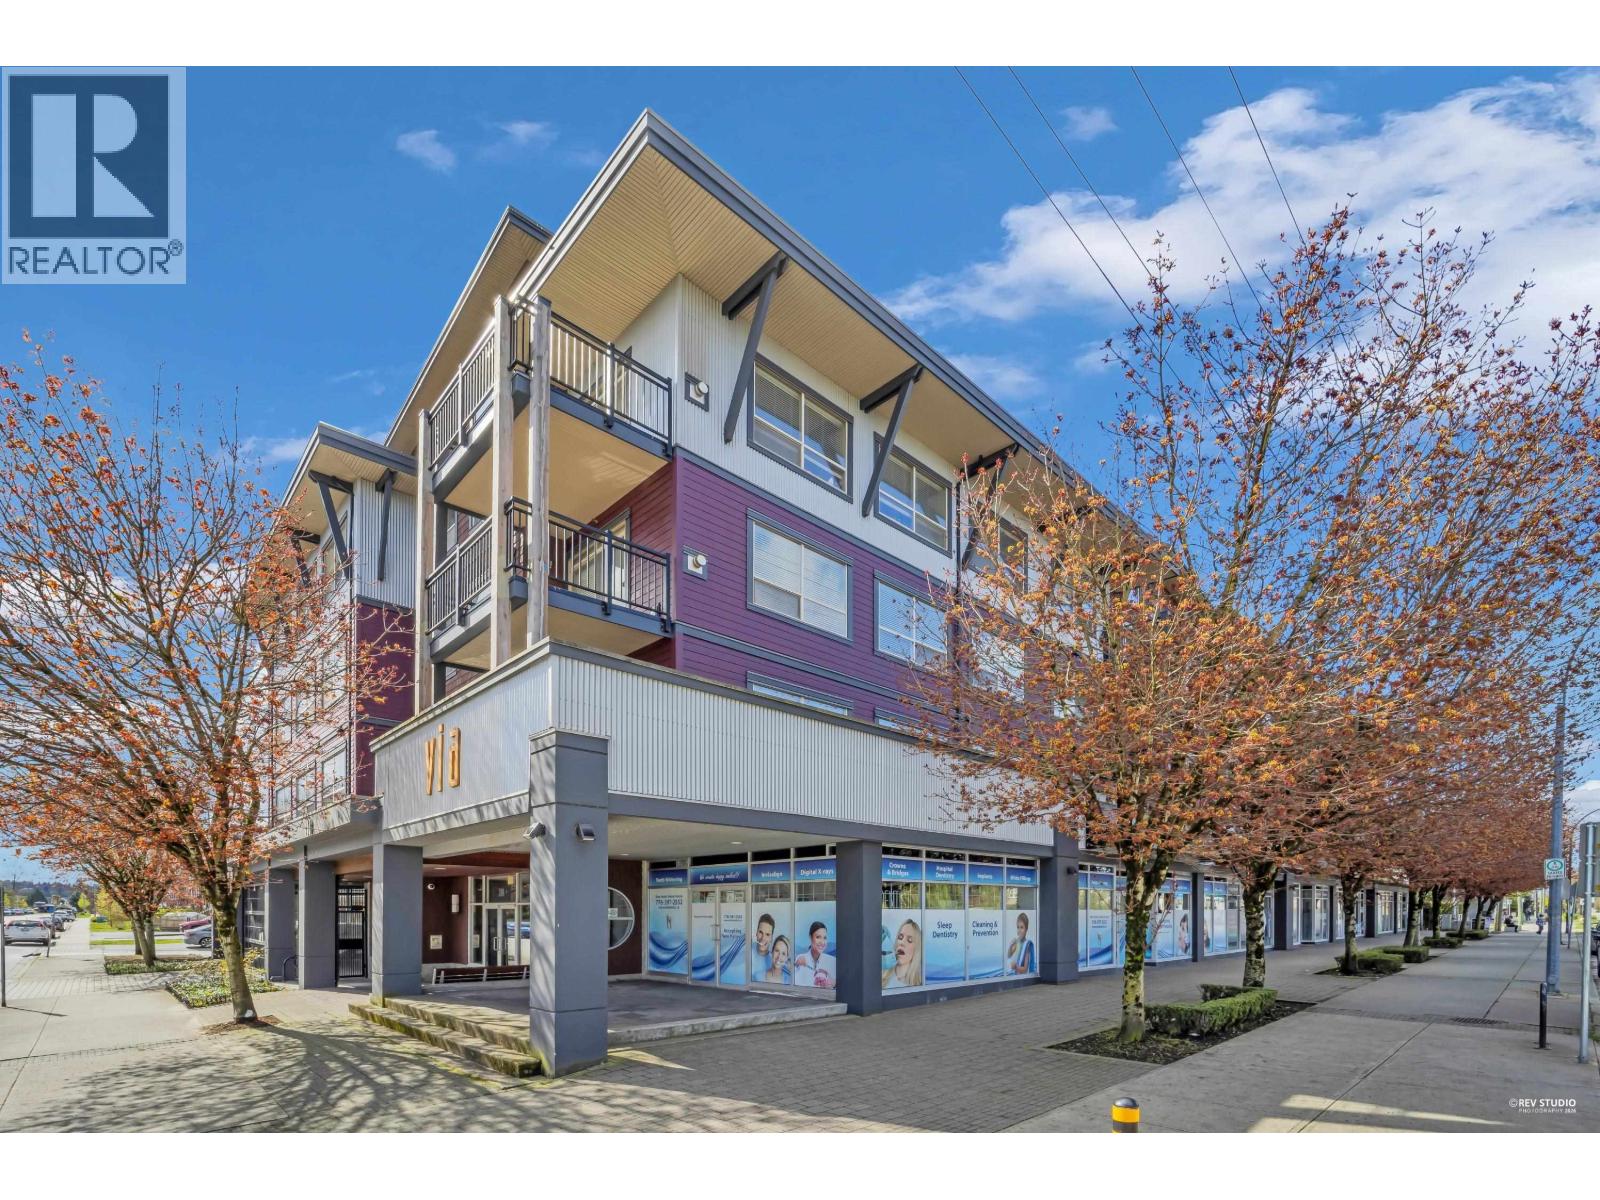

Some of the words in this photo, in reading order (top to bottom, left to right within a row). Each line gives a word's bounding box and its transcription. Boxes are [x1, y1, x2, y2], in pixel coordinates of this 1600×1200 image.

[424, 723, 462, 796] via
[800, 868, 817, 876] Digital
[936, 921, 953, 930] Sleep
[972, 921, 993, 930] Cleaning
[932, 931, 958, 939] Dentistry
